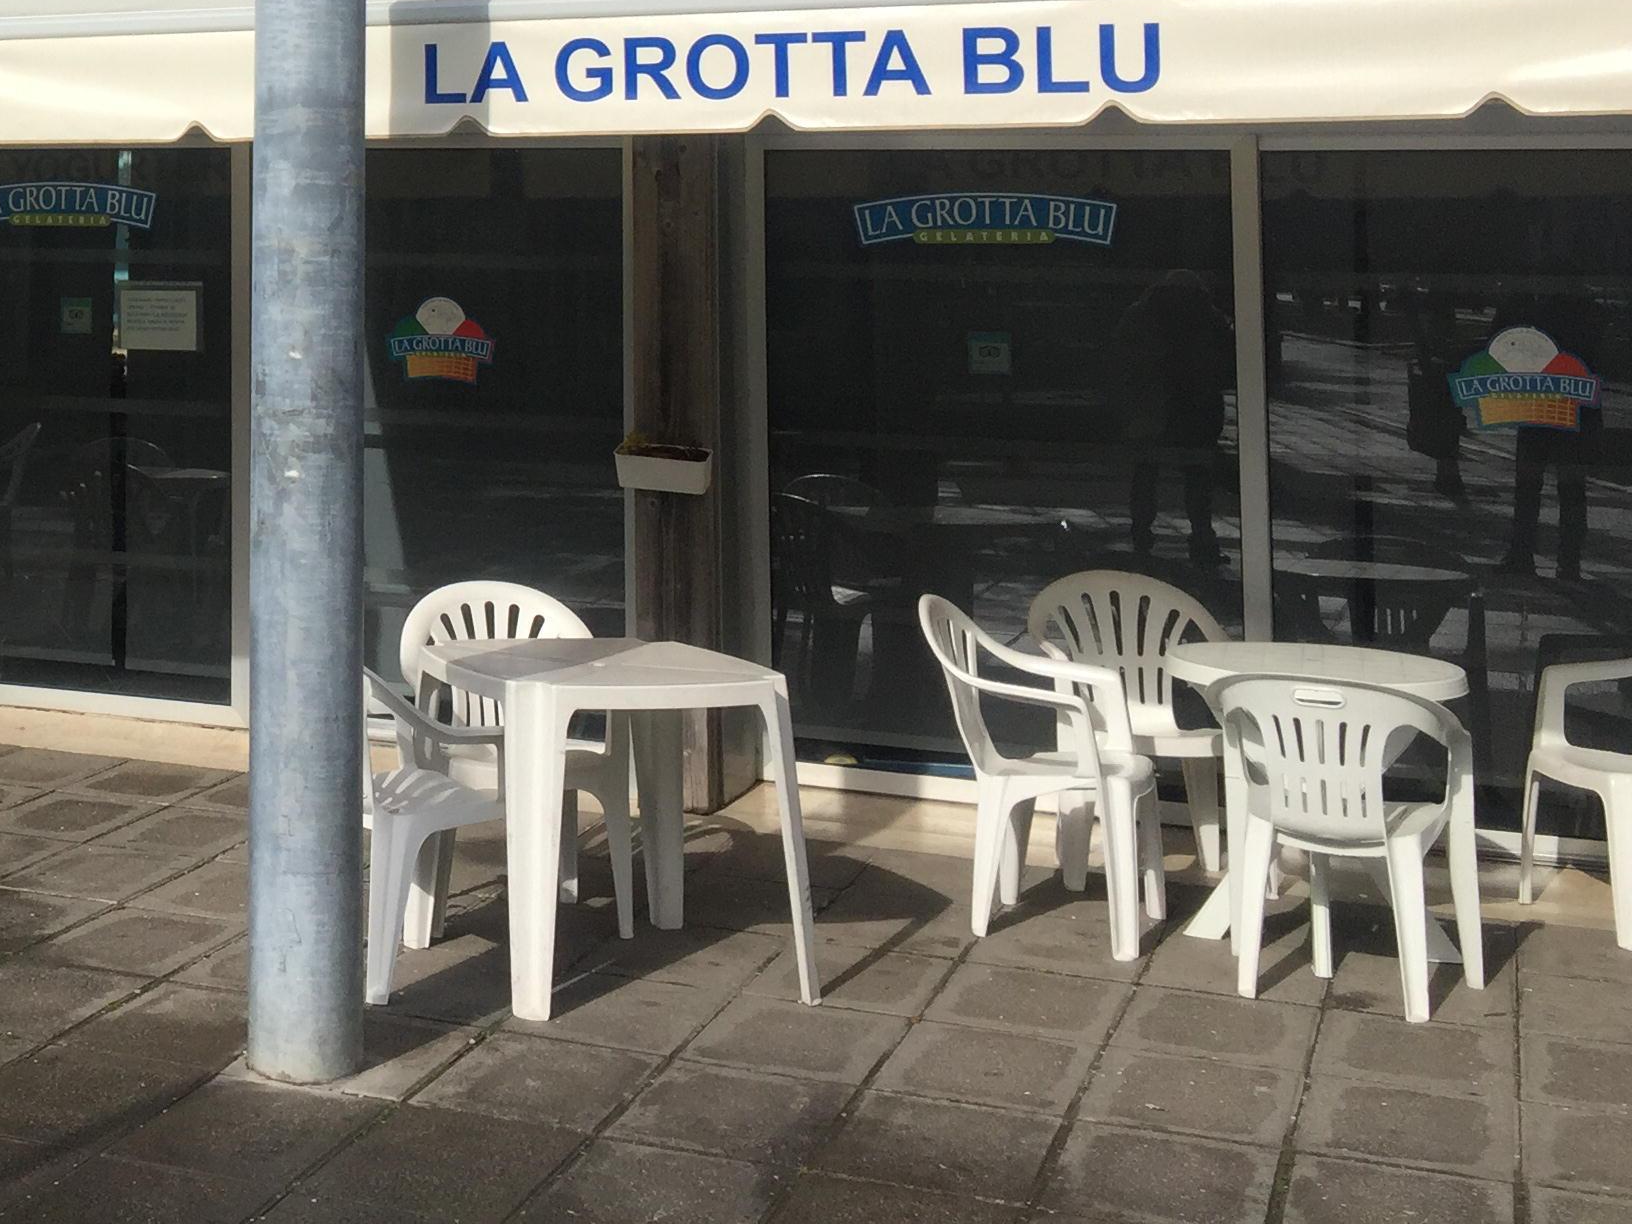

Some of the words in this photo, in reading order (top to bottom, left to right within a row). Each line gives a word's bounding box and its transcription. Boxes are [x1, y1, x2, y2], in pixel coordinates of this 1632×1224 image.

[424, 41, 529, 105] LA
[554, 29, 932, 102] GROTTA
[962, 22, 1161, 95] BLU
[8, 186, 100, 212] GROTTA
[106, 190, 149, 220] BLU
[12, 216, 107, 225] GELATERIA
[865, 205, 904, 236] LA
[911, 197, 1037, 228] GROTTA
[1049, 200, 1106, 236] BLU
[919, 231, 1049, 241] GELATERIA
[395, 339, 410, 352] LA
[413, 337, 462, 350] GROTTA
[1461, 380, 1483, 395] LA
[1486, 375, 1554, 391] GROTTA
[1560, 379, 1591, 396] BLU
